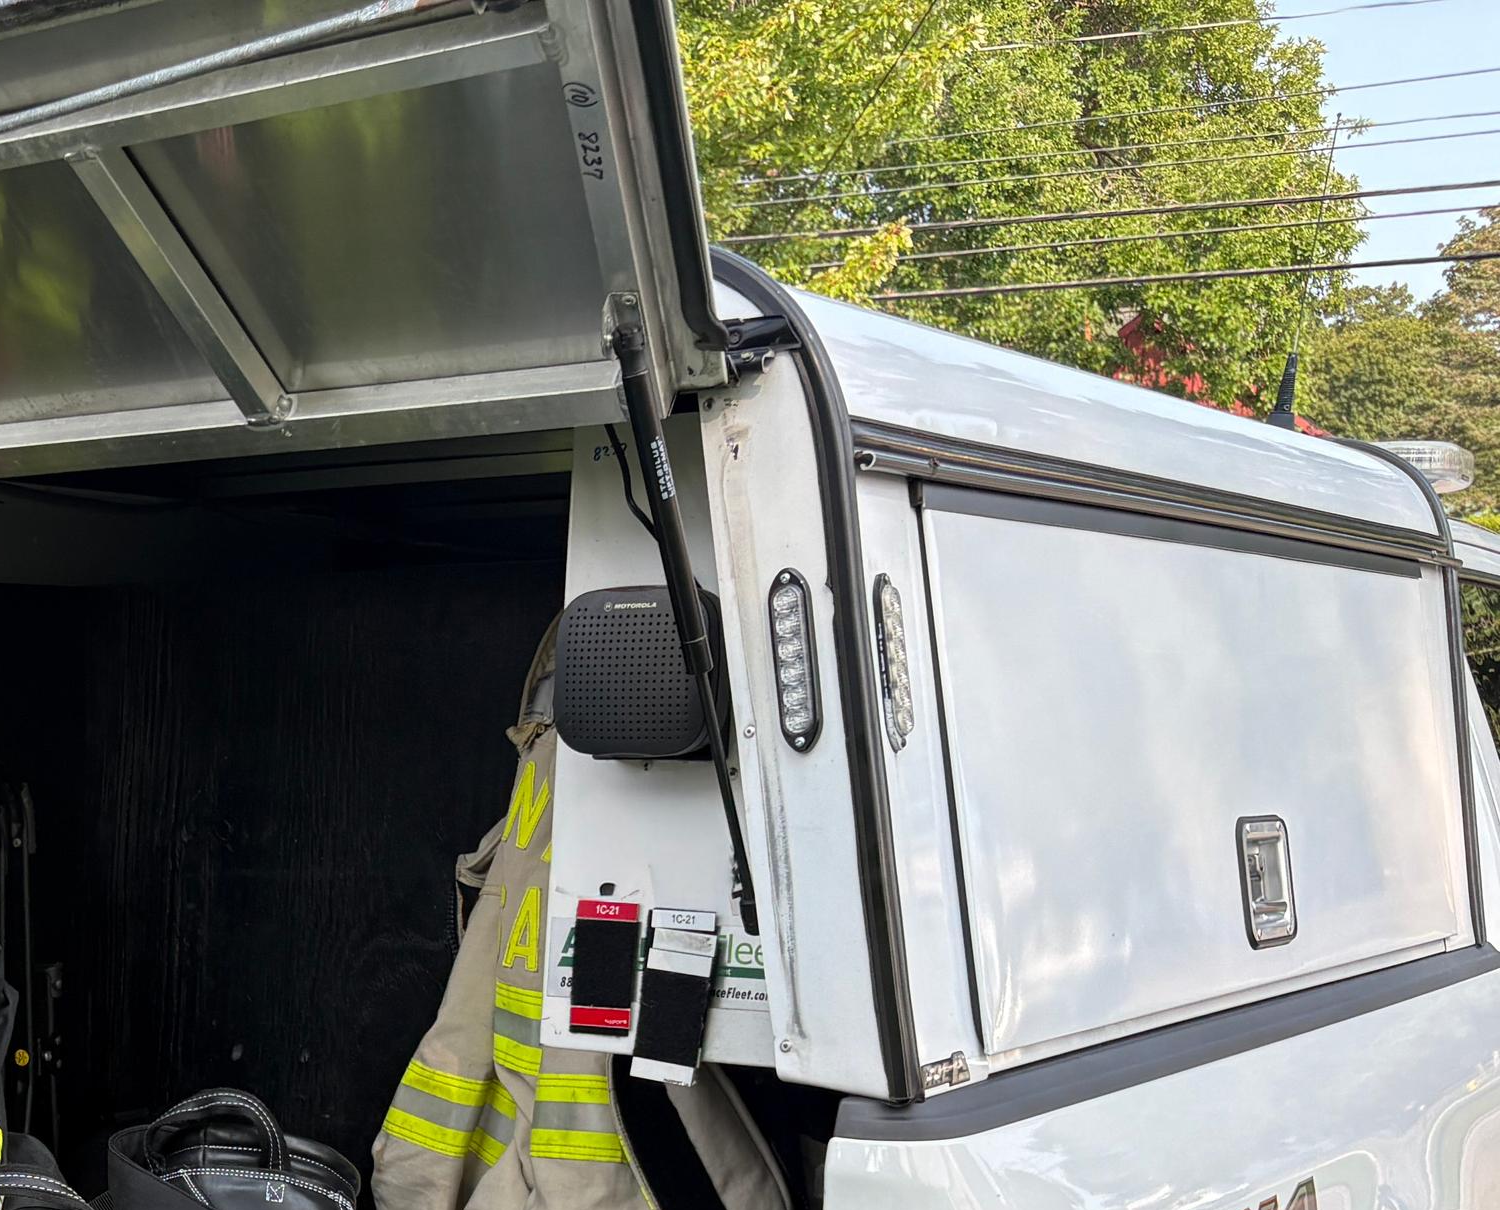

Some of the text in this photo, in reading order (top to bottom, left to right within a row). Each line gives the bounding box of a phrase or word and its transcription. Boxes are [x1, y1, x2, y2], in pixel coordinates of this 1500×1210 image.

[578, 132, 604, 180] 8237
[650, 441, 669, 500] STABILUS
[613, 602, 657, 610] MOTOROLA
[595, 904, 620, 916] 1C-21
[671, 913, 696, 925] 1C-21
